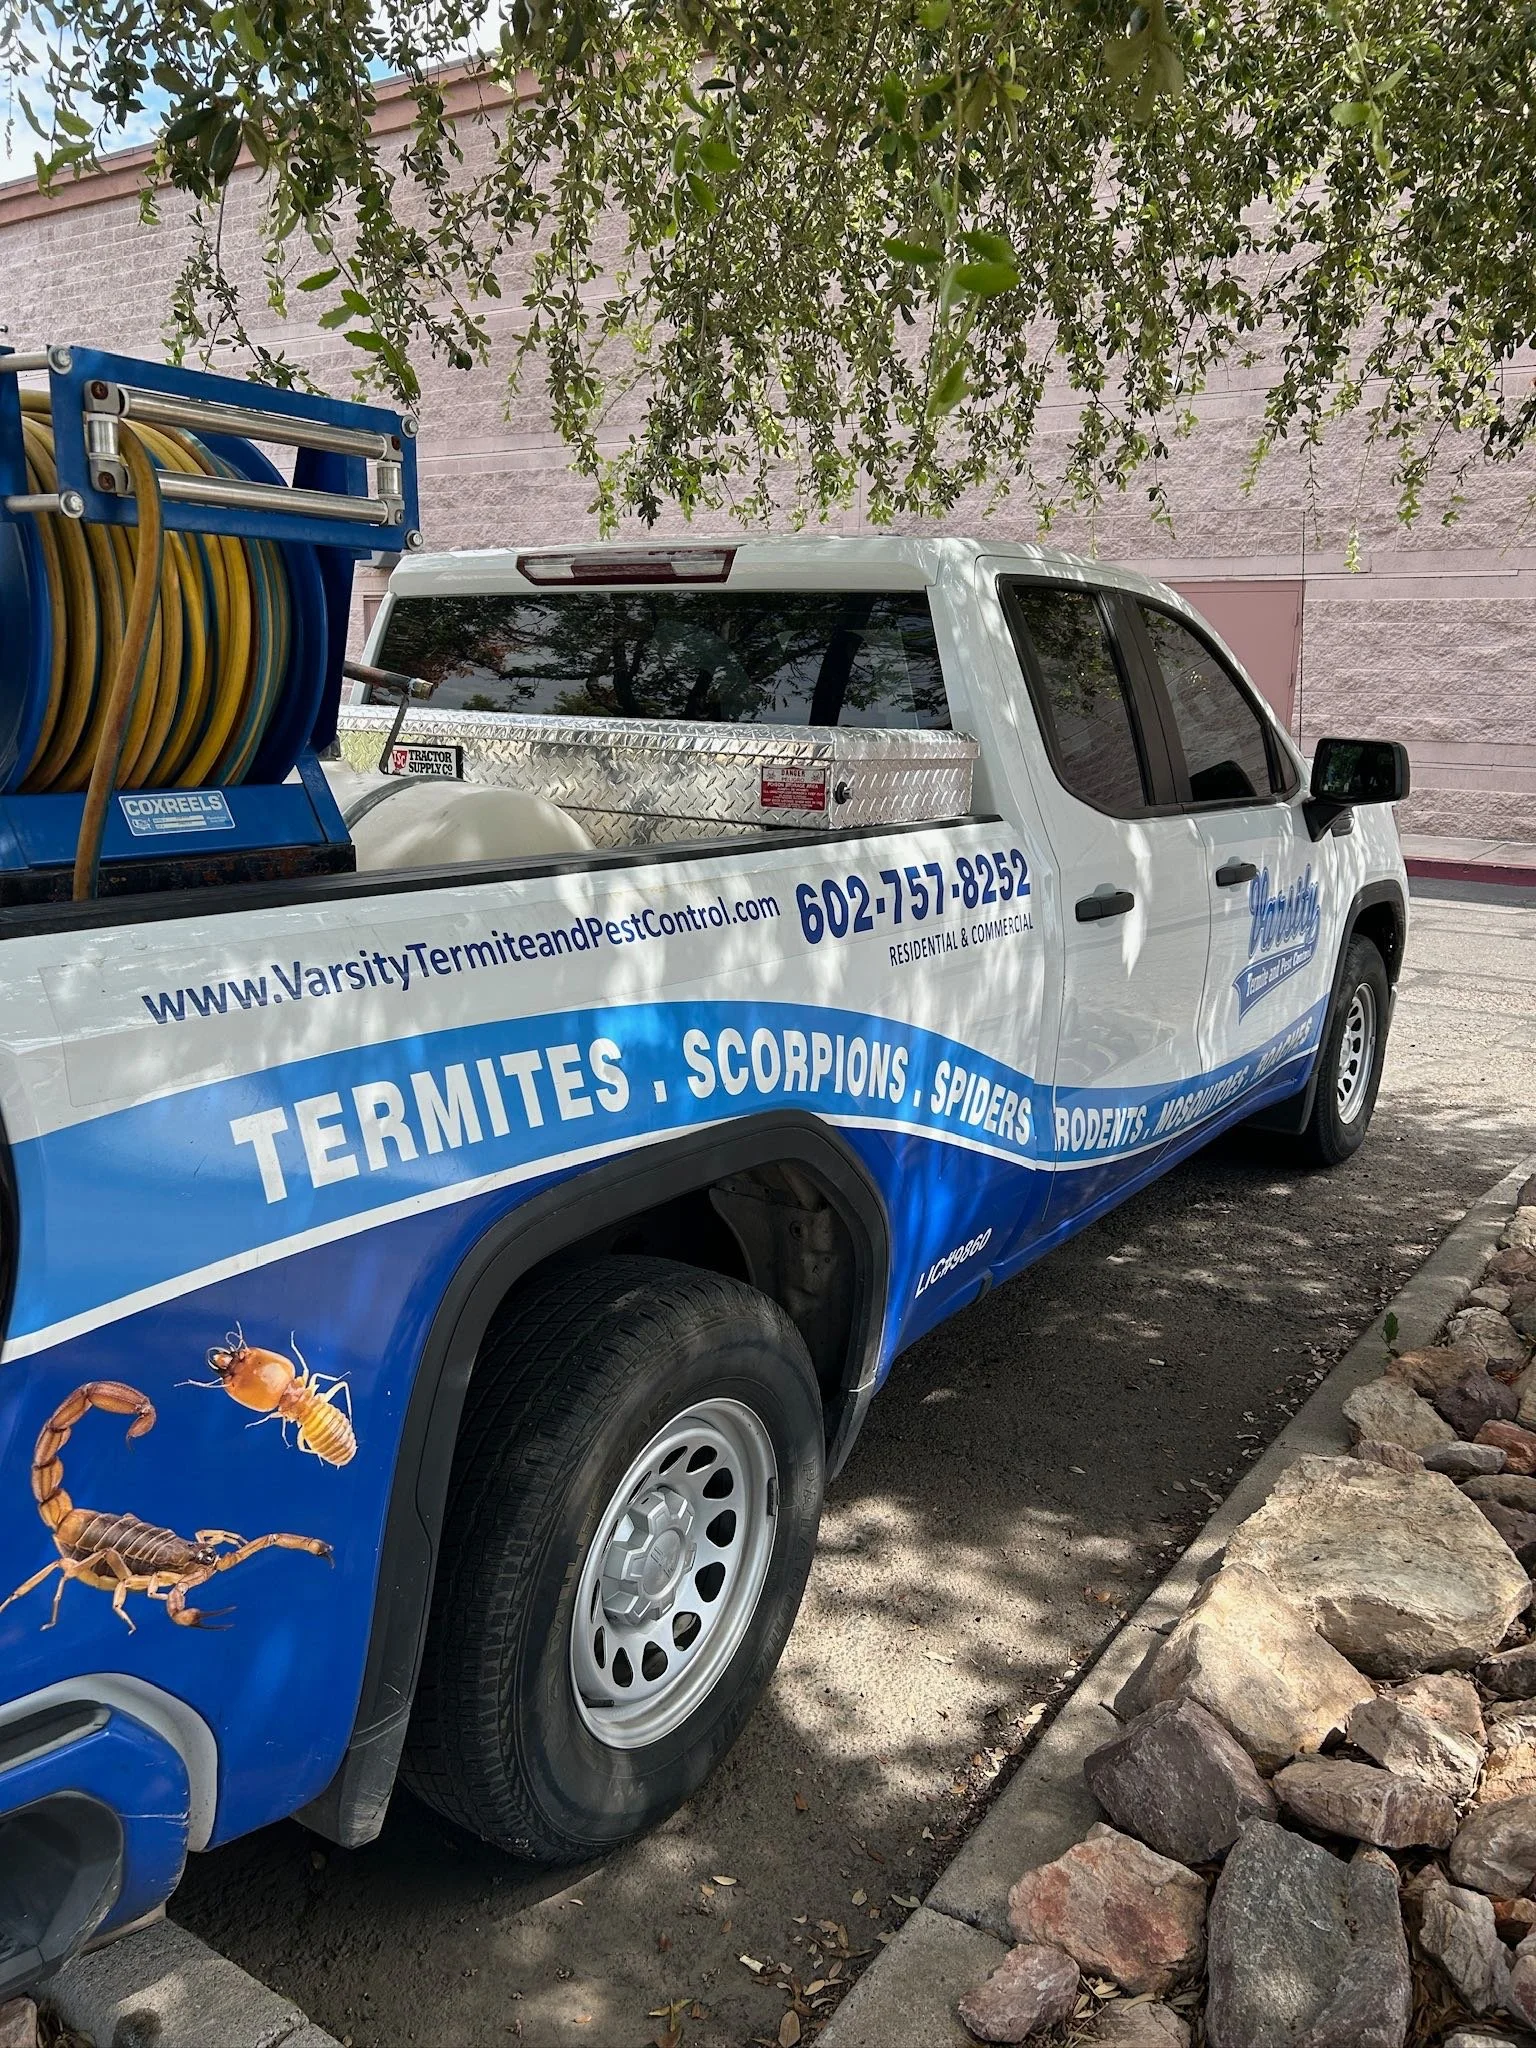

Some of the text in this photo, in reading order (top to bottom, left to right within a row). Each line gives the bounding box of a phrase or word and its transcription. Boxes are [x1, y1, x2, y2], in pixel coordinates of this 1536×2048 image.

[409, 750, 452, 763] TRACTOR
[409, 762, 441, 774] SUPPLY
[781, 769, 805, 777] DANGER
[125, 795, 222, 816] COXREELS
[1248, 863, 1320, 959] Varsity
[141, 893, 781, 1024] www.VarsityTermiteandPestControl.com
[889, 912, 1034, 967] RESIDENTIAL & COMMERCIAL
[1268, 959, 1280, 982] and
[1280, 957, 1293, 975] Pest
[230, 1038, 630, 1204] TERMITES
[683, 1028, 908, 1103] SCORPIONS
[930, 1060, 1031, 1146] SPIDERS
[915, 1228, 992, 1299] LIC#9860
